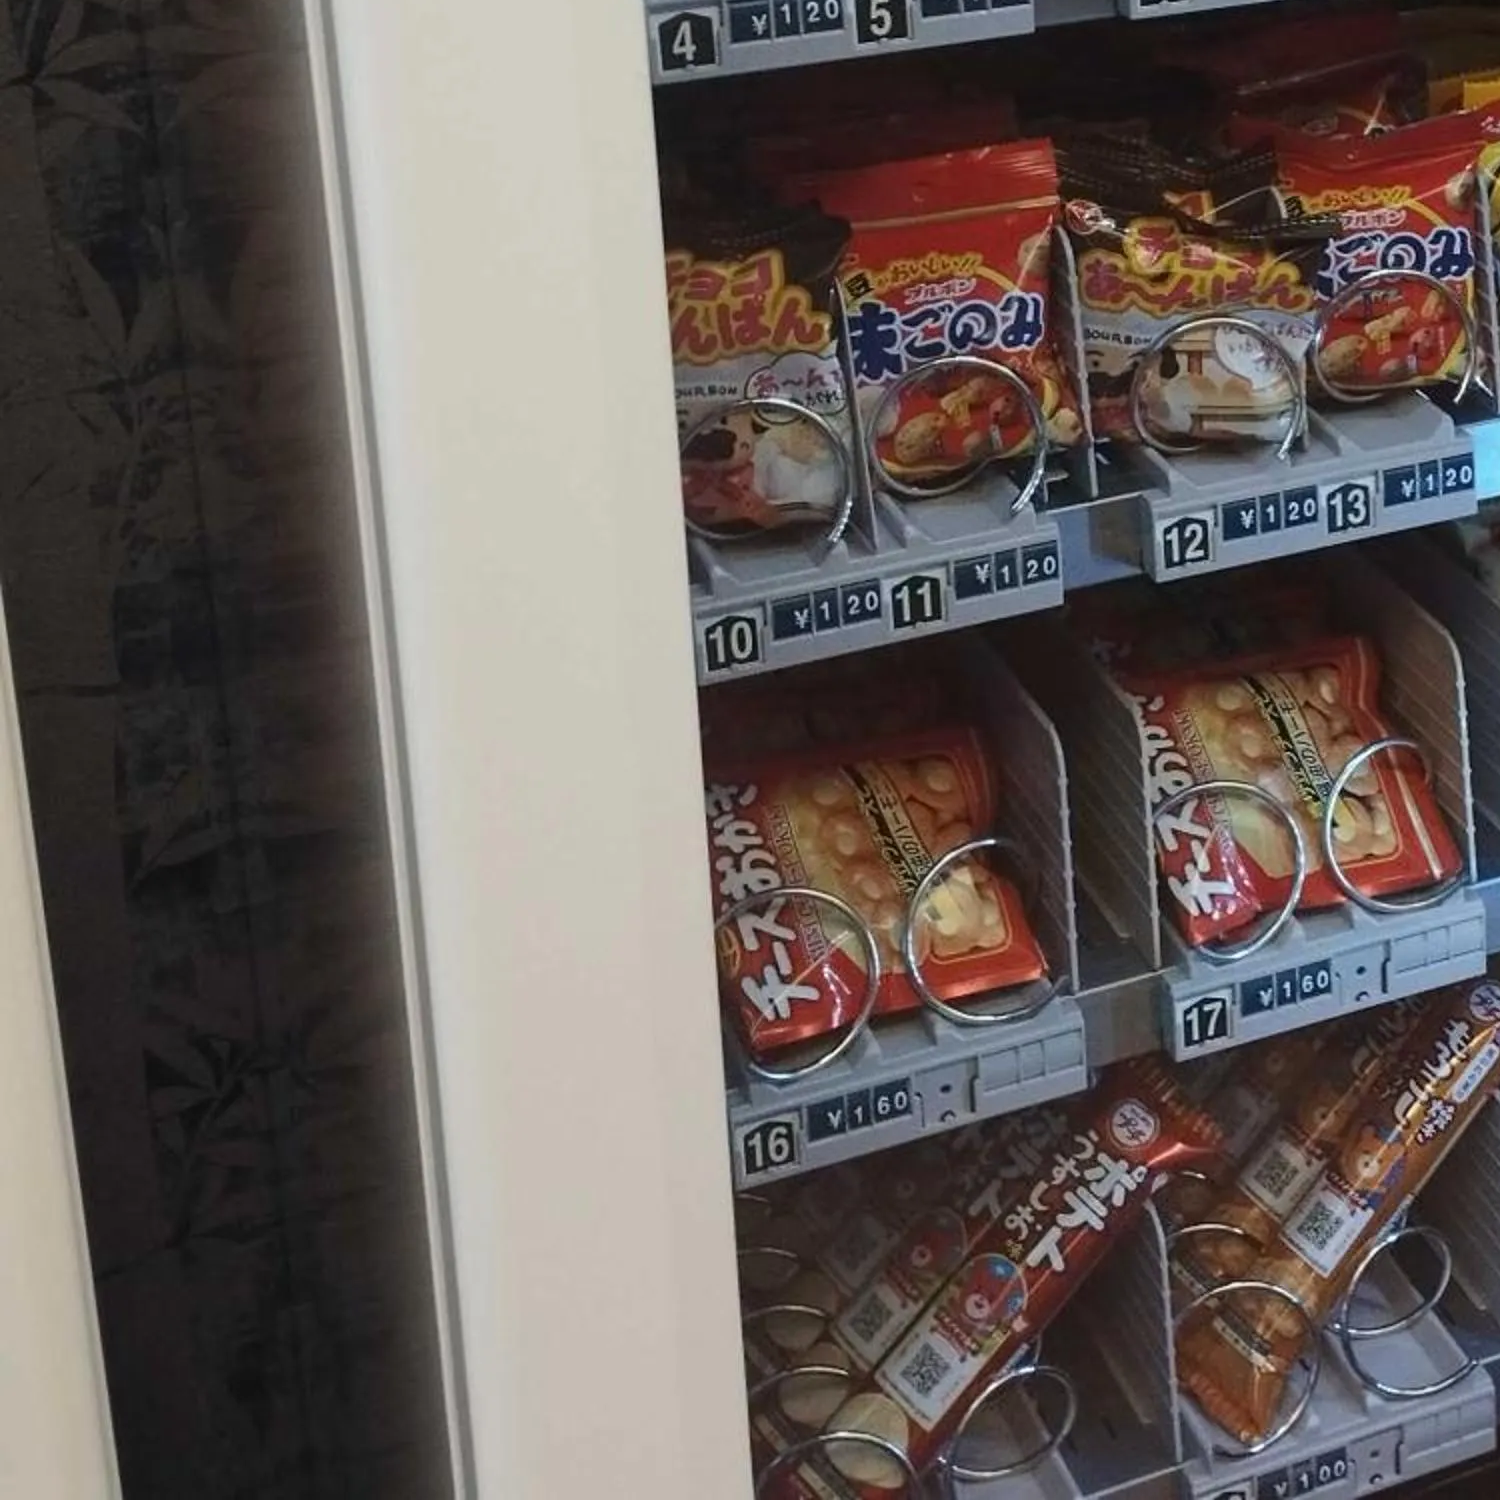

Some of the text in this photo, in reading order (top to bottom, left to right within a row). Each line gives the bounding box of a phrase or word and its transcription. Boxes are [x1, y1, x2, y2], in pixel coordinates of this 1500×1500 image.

[671, 22, 697, 63] 4
[1316, 227, 1475, 299] ごのみ
[1166, 497, 1317, 565] 12 ¥120
[1329, 465, 1473, 528] 13 ¥120
[895, 554, 1057, 625] 11 ¥120
[707, 590, 880, 668] 10 ¥120
[1134, 694, 1236, 920] チーズおか
[705, 782, 821, 1023] チーズおかき
[1185, 1002, 1224, 1042] 17
[746, 1128, 792, 1171] 16
[1026, 1153, 1150, 1272] ポテト
